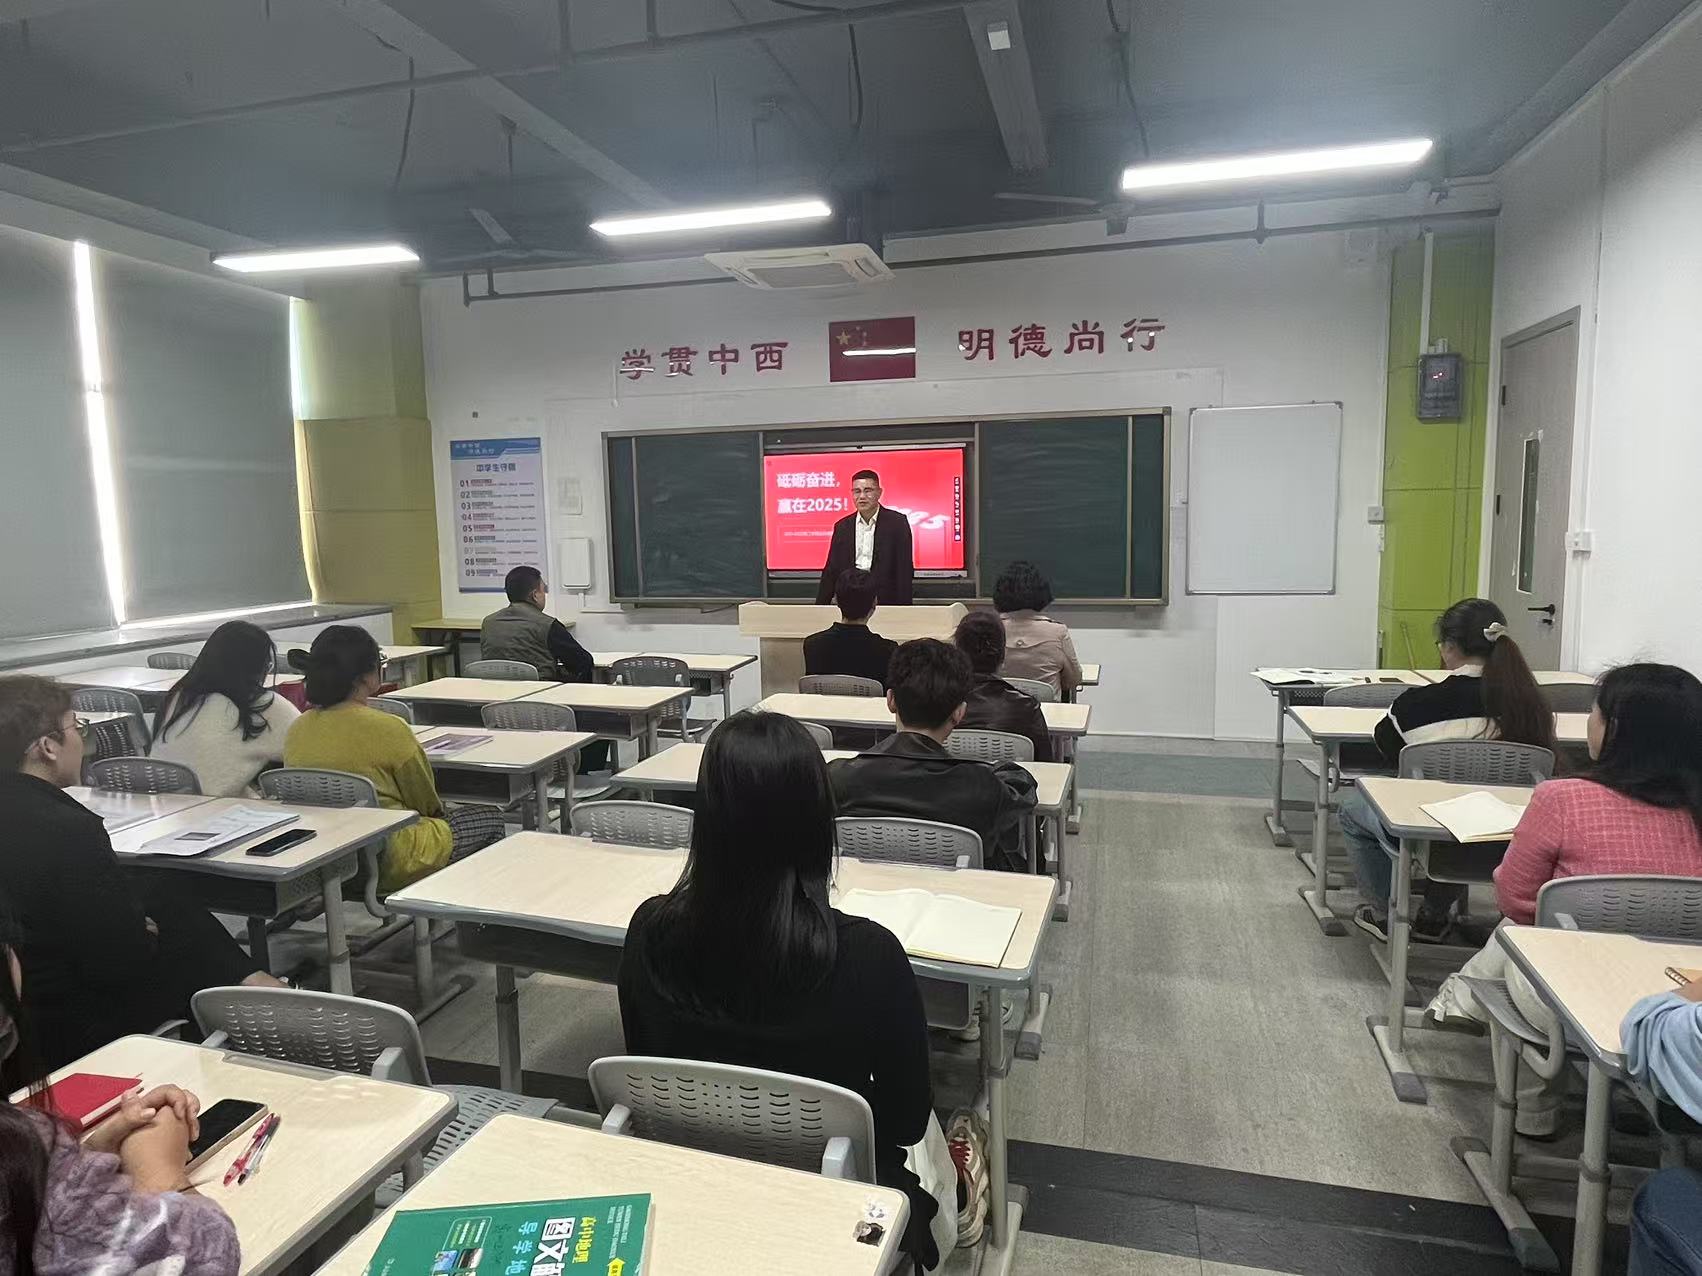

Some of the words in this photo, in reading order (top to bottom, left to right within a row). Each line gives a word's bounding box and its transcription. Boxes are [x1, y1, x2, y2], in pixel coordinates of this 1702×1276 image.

[958, 317, 1166, 361] 明德尚行
[619, 341, 790, 380] 学贯中西
[459, 480, 469, 488] 01
[460, 491, 470, 499] 02
[461, 502, 471, 510] 03
[572, 1216, 597, 1264] 高中地理
